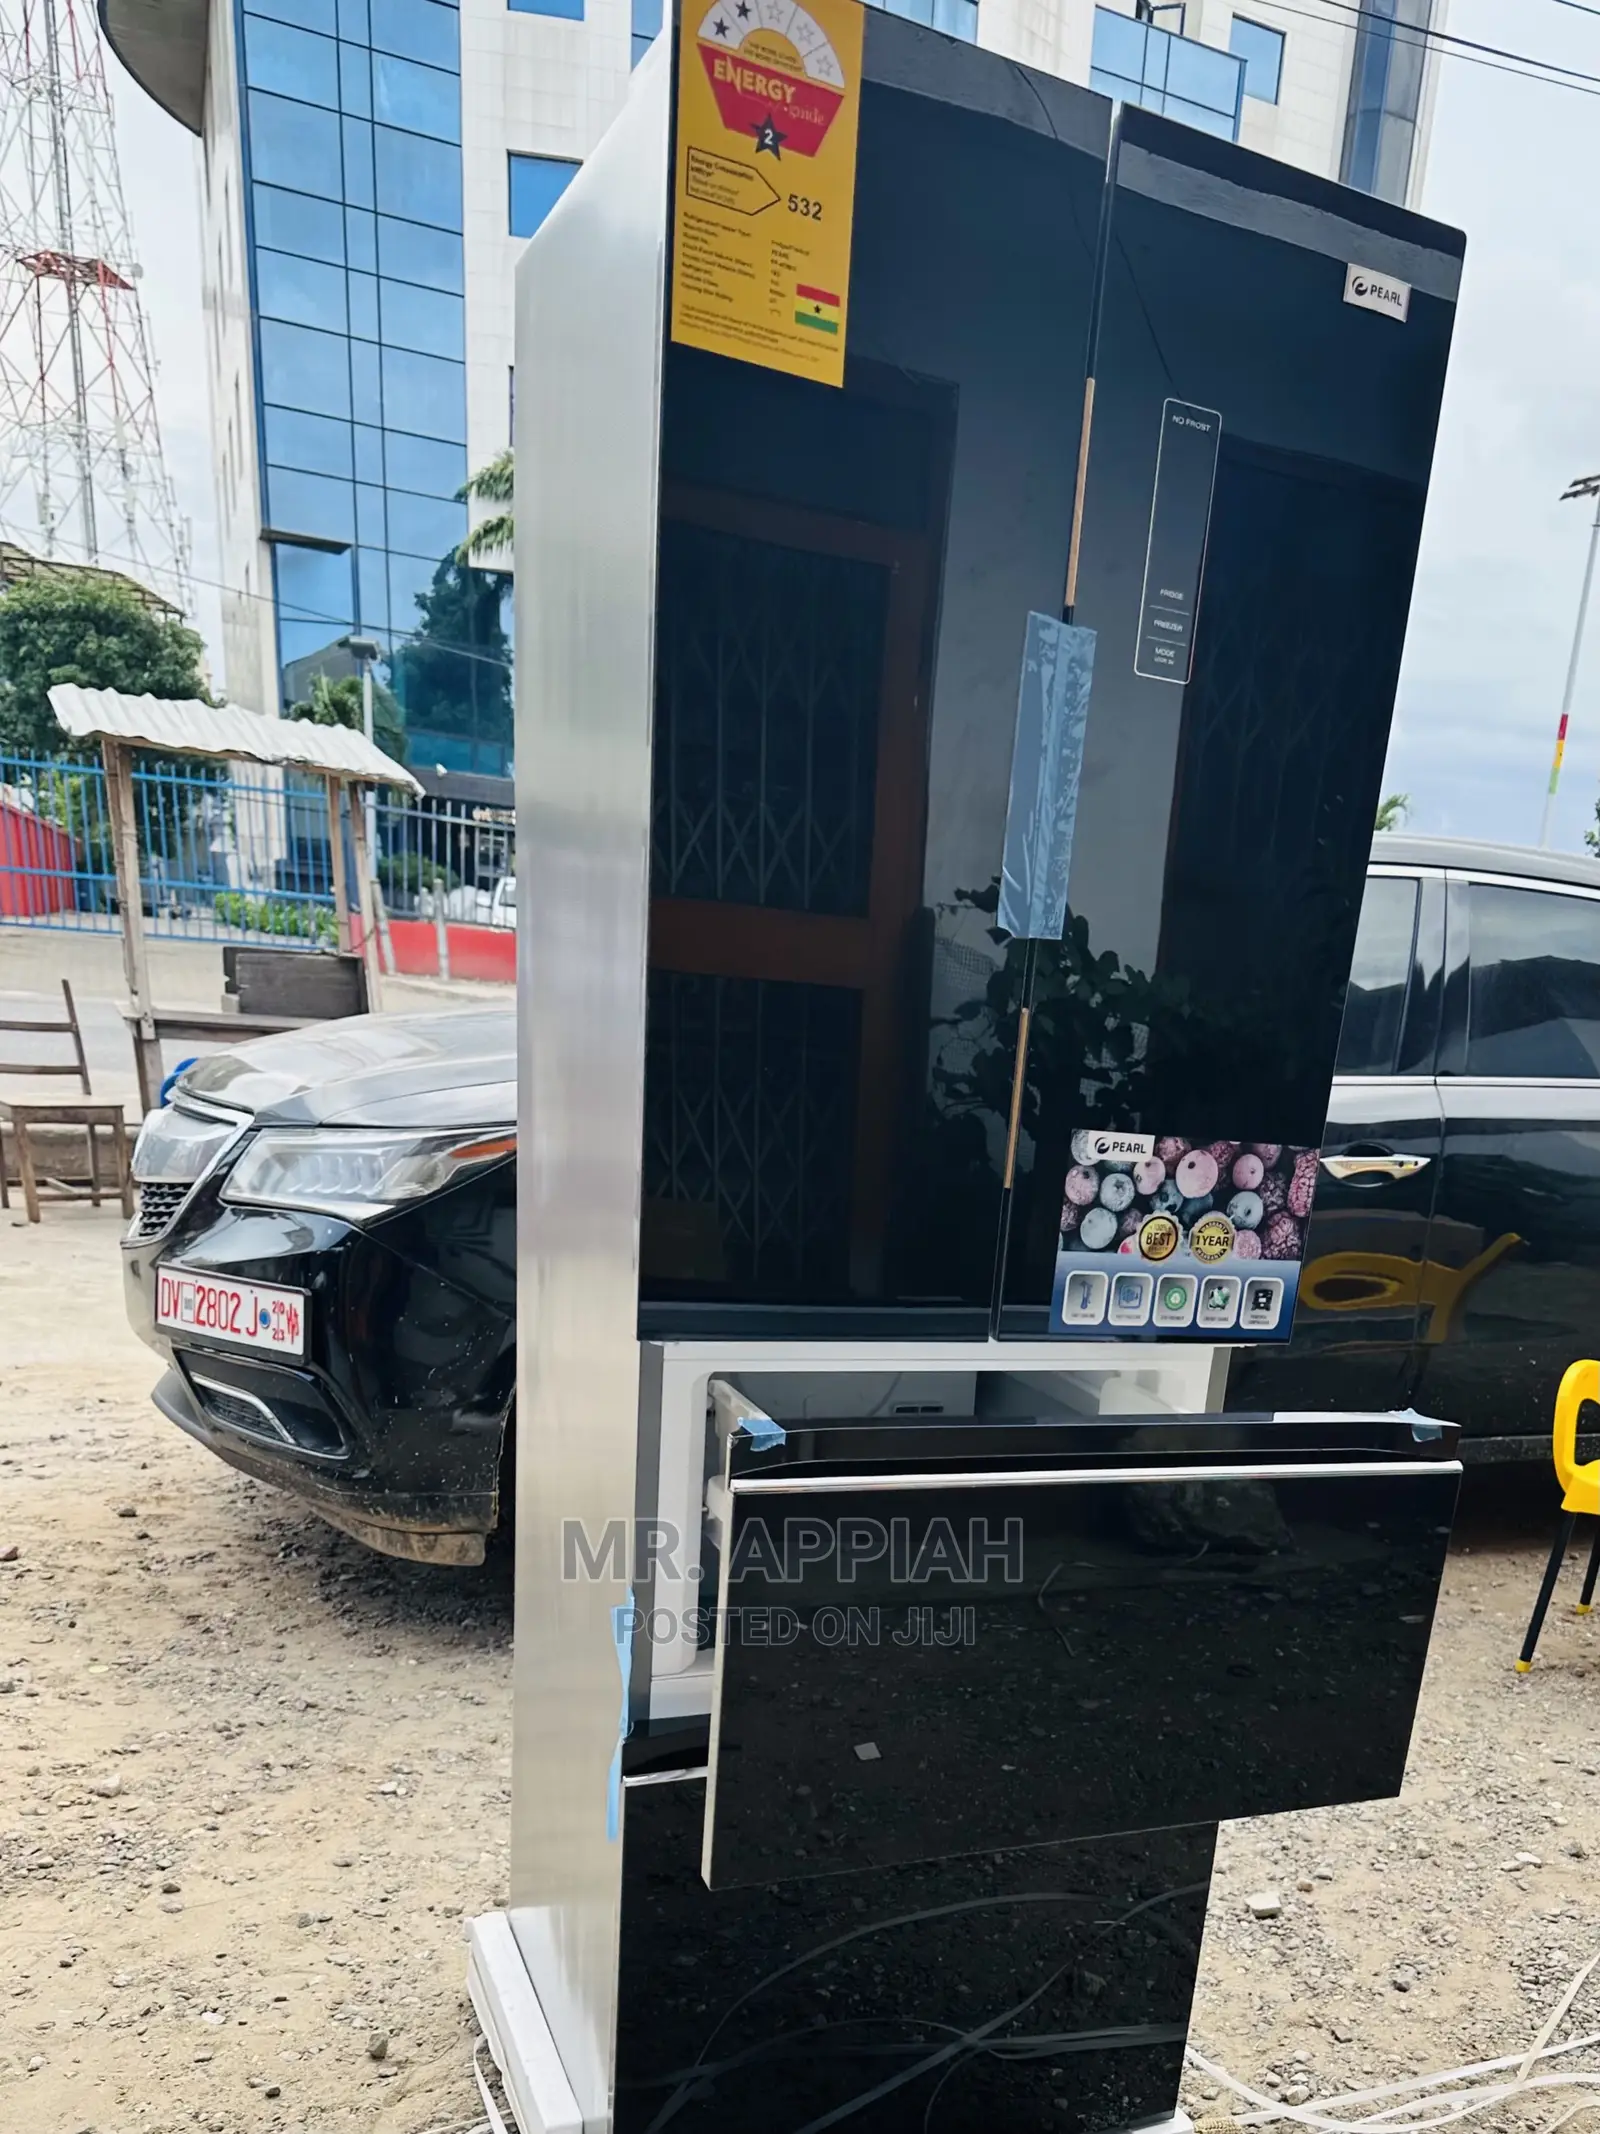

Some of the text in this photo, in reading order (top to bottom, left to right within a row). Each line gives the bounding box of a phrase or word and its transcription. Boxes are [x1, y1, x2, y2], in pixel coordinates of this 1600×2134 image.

[713, 56, 796, 104] ENERGY
[764, 129, 774, 145] 2
[788, 193, 823, 221] 532
[1370, 284, 1402, 307] PEARL
[1172, 415, 1211, 432] NO FROST
[1154, 619, 1183, 632] FREEZER
[1155, 647, 1175, 657] MODE
[1112, 1141, 1147, 1154] PEARL
[1146, 1232, 1172, 1246] BEST
[1202, 1236, 1229, 1246] YEAR
[162, 1278, 180, 1319] DV
[195, 1286, 242, 1333] 2802
[246, 1296, 258, 1337] J
